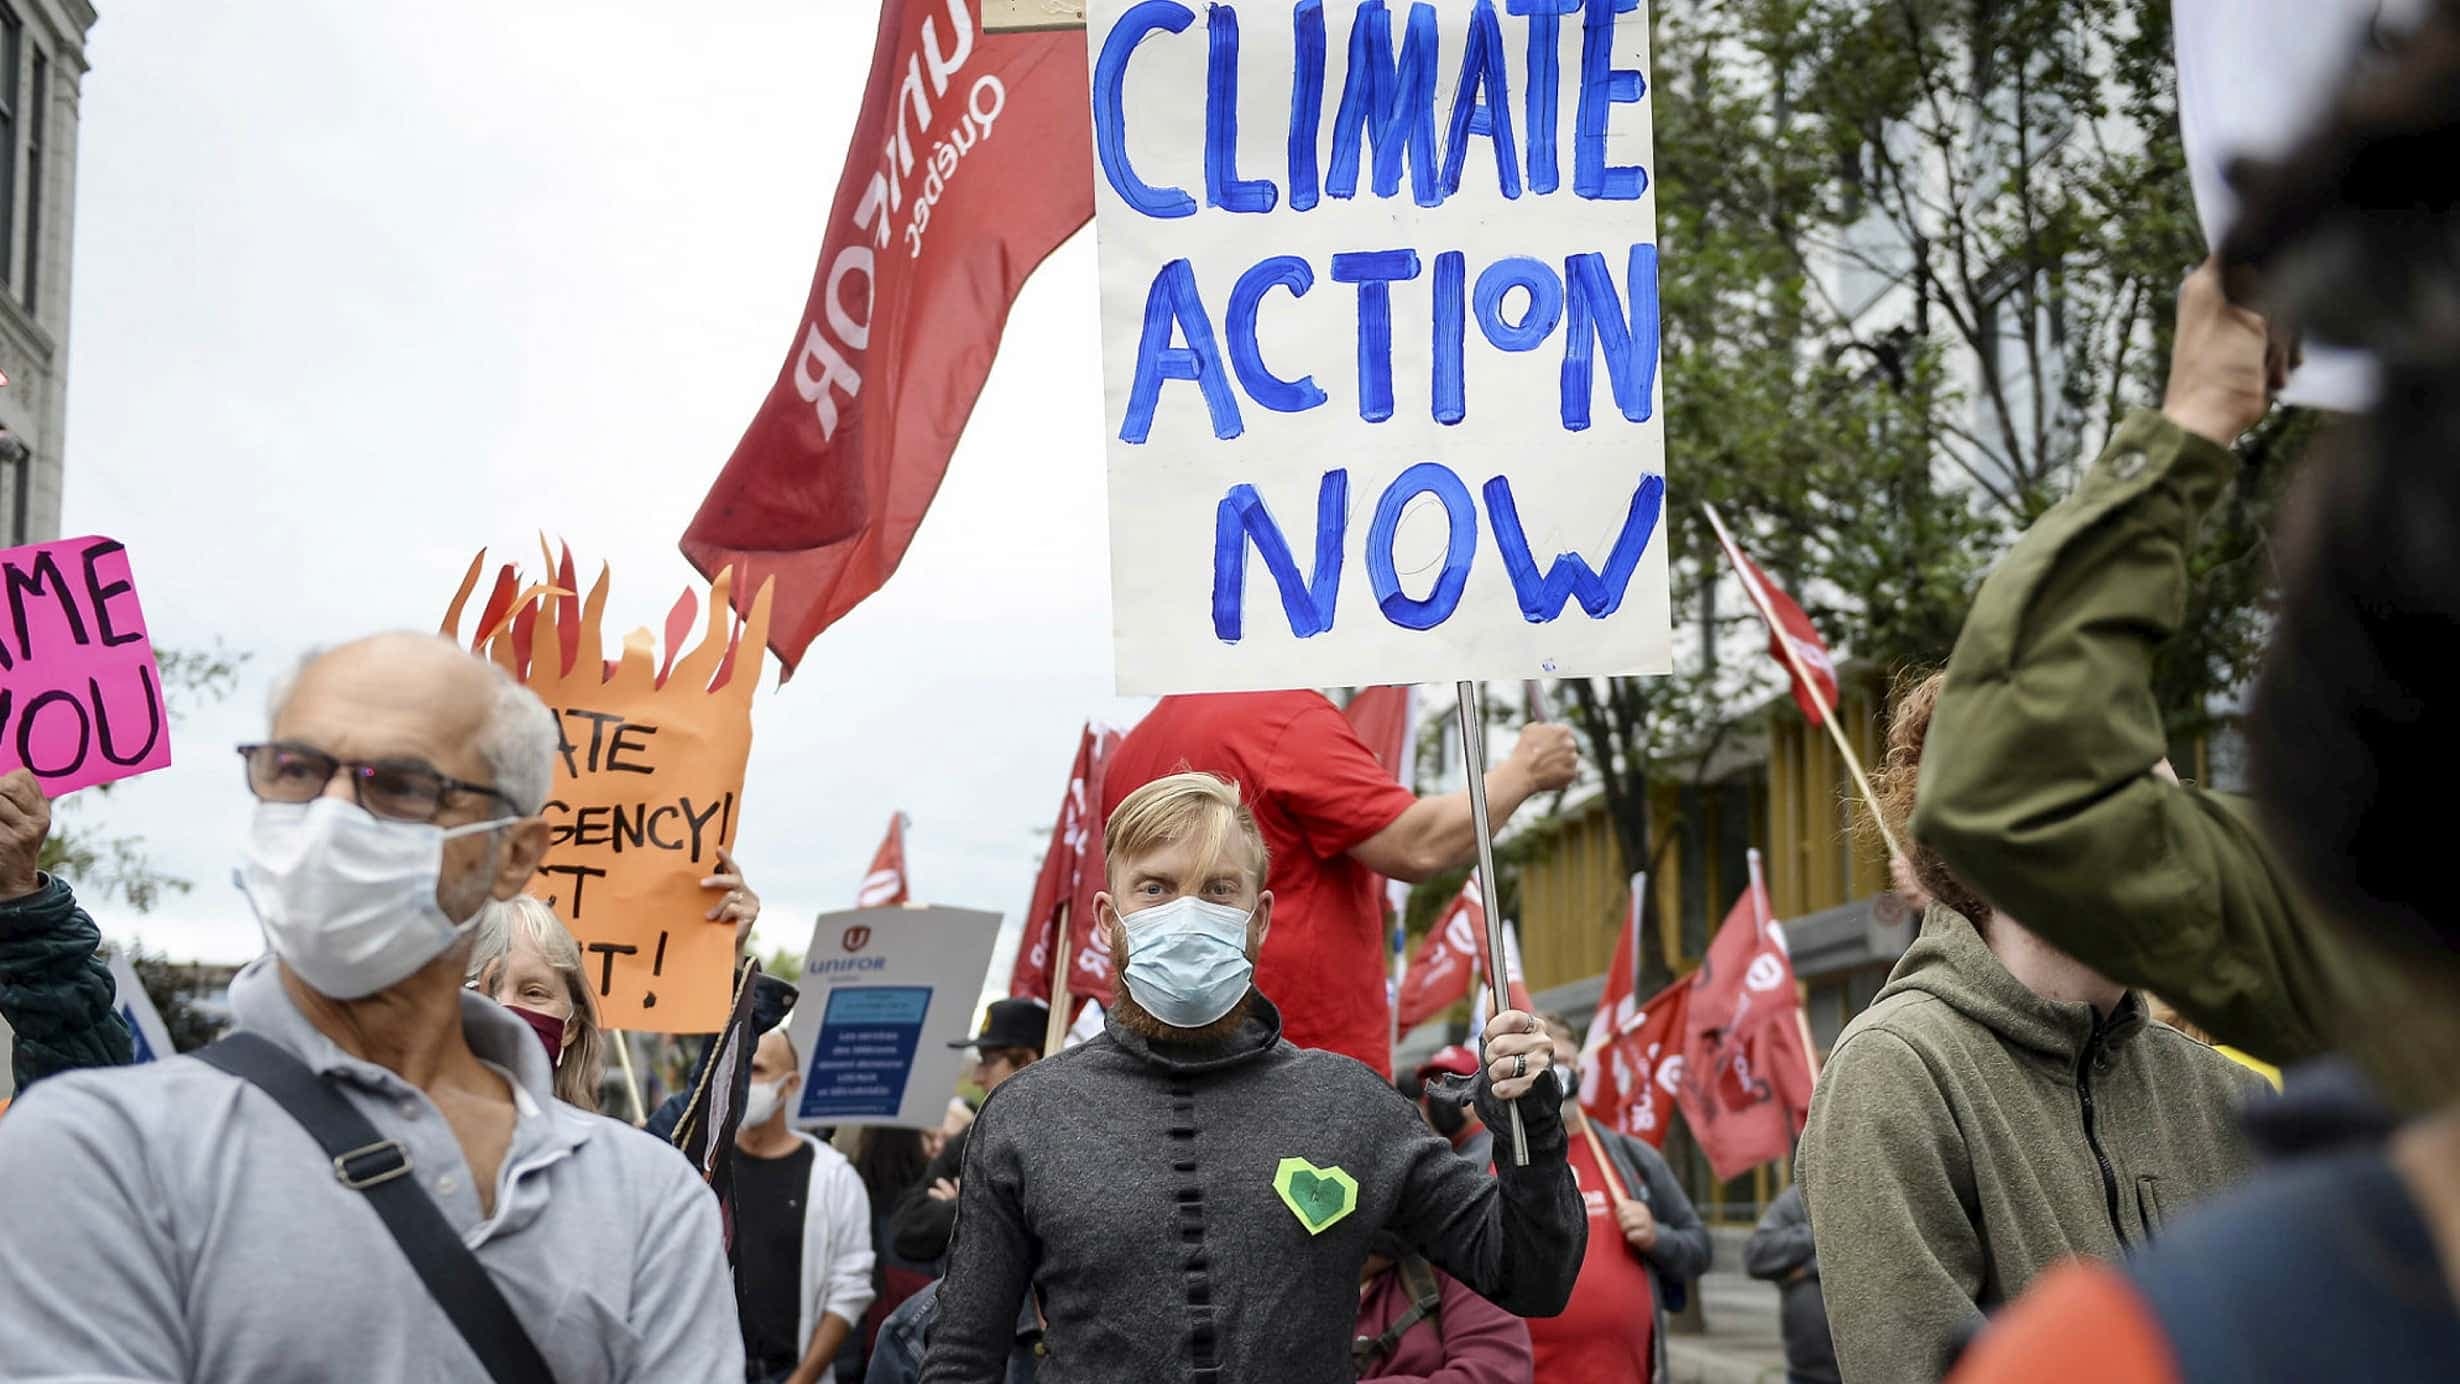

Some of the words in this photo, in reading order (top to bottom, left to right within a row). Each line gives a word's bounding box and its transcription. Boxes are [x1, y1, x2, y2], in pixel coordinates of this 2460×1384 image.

[1092, 0, 1648, 219] CLIMATE
[1119, 242, 1660, 444] ACTION
[1212, 462, 1665, 645] NOW
